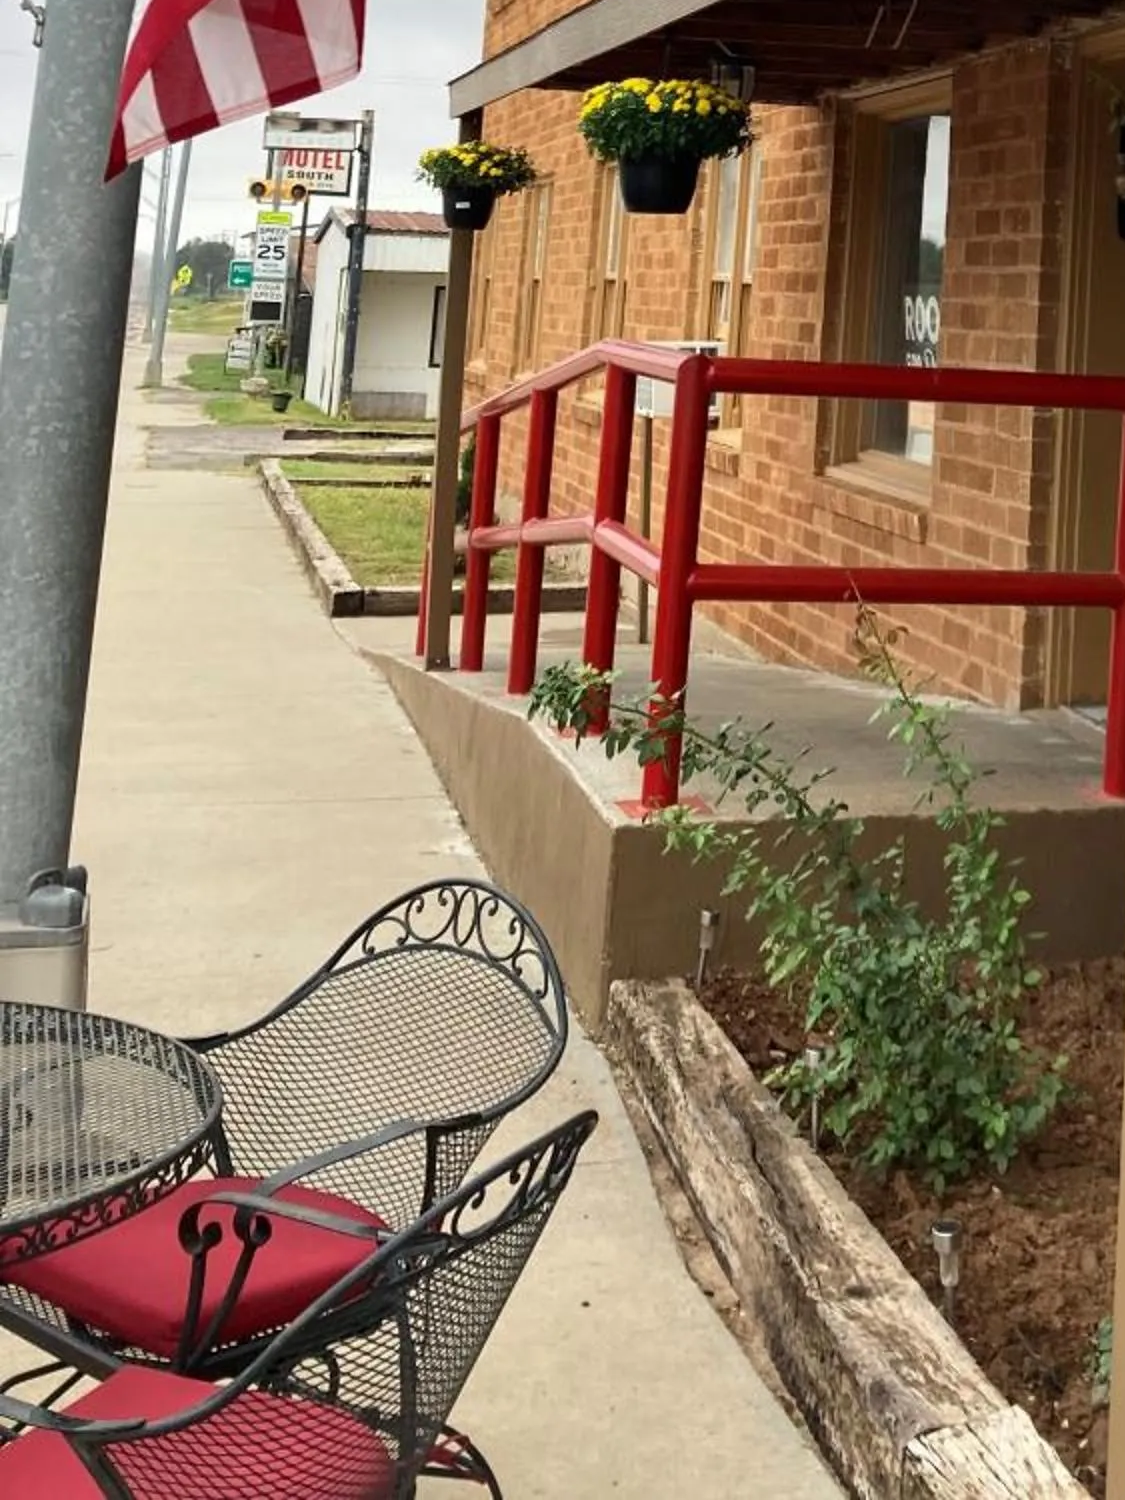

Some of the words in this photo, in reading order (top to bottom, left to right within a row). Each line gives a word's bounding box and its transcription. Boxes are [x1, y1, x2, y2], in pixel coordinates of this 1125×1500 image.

[279, 148, 345, 171] MOTEL
[287, 169, 334, 181] SOUTH
[257, 244, 286, 260] 25
[904, 294, 940, 344] ROO
